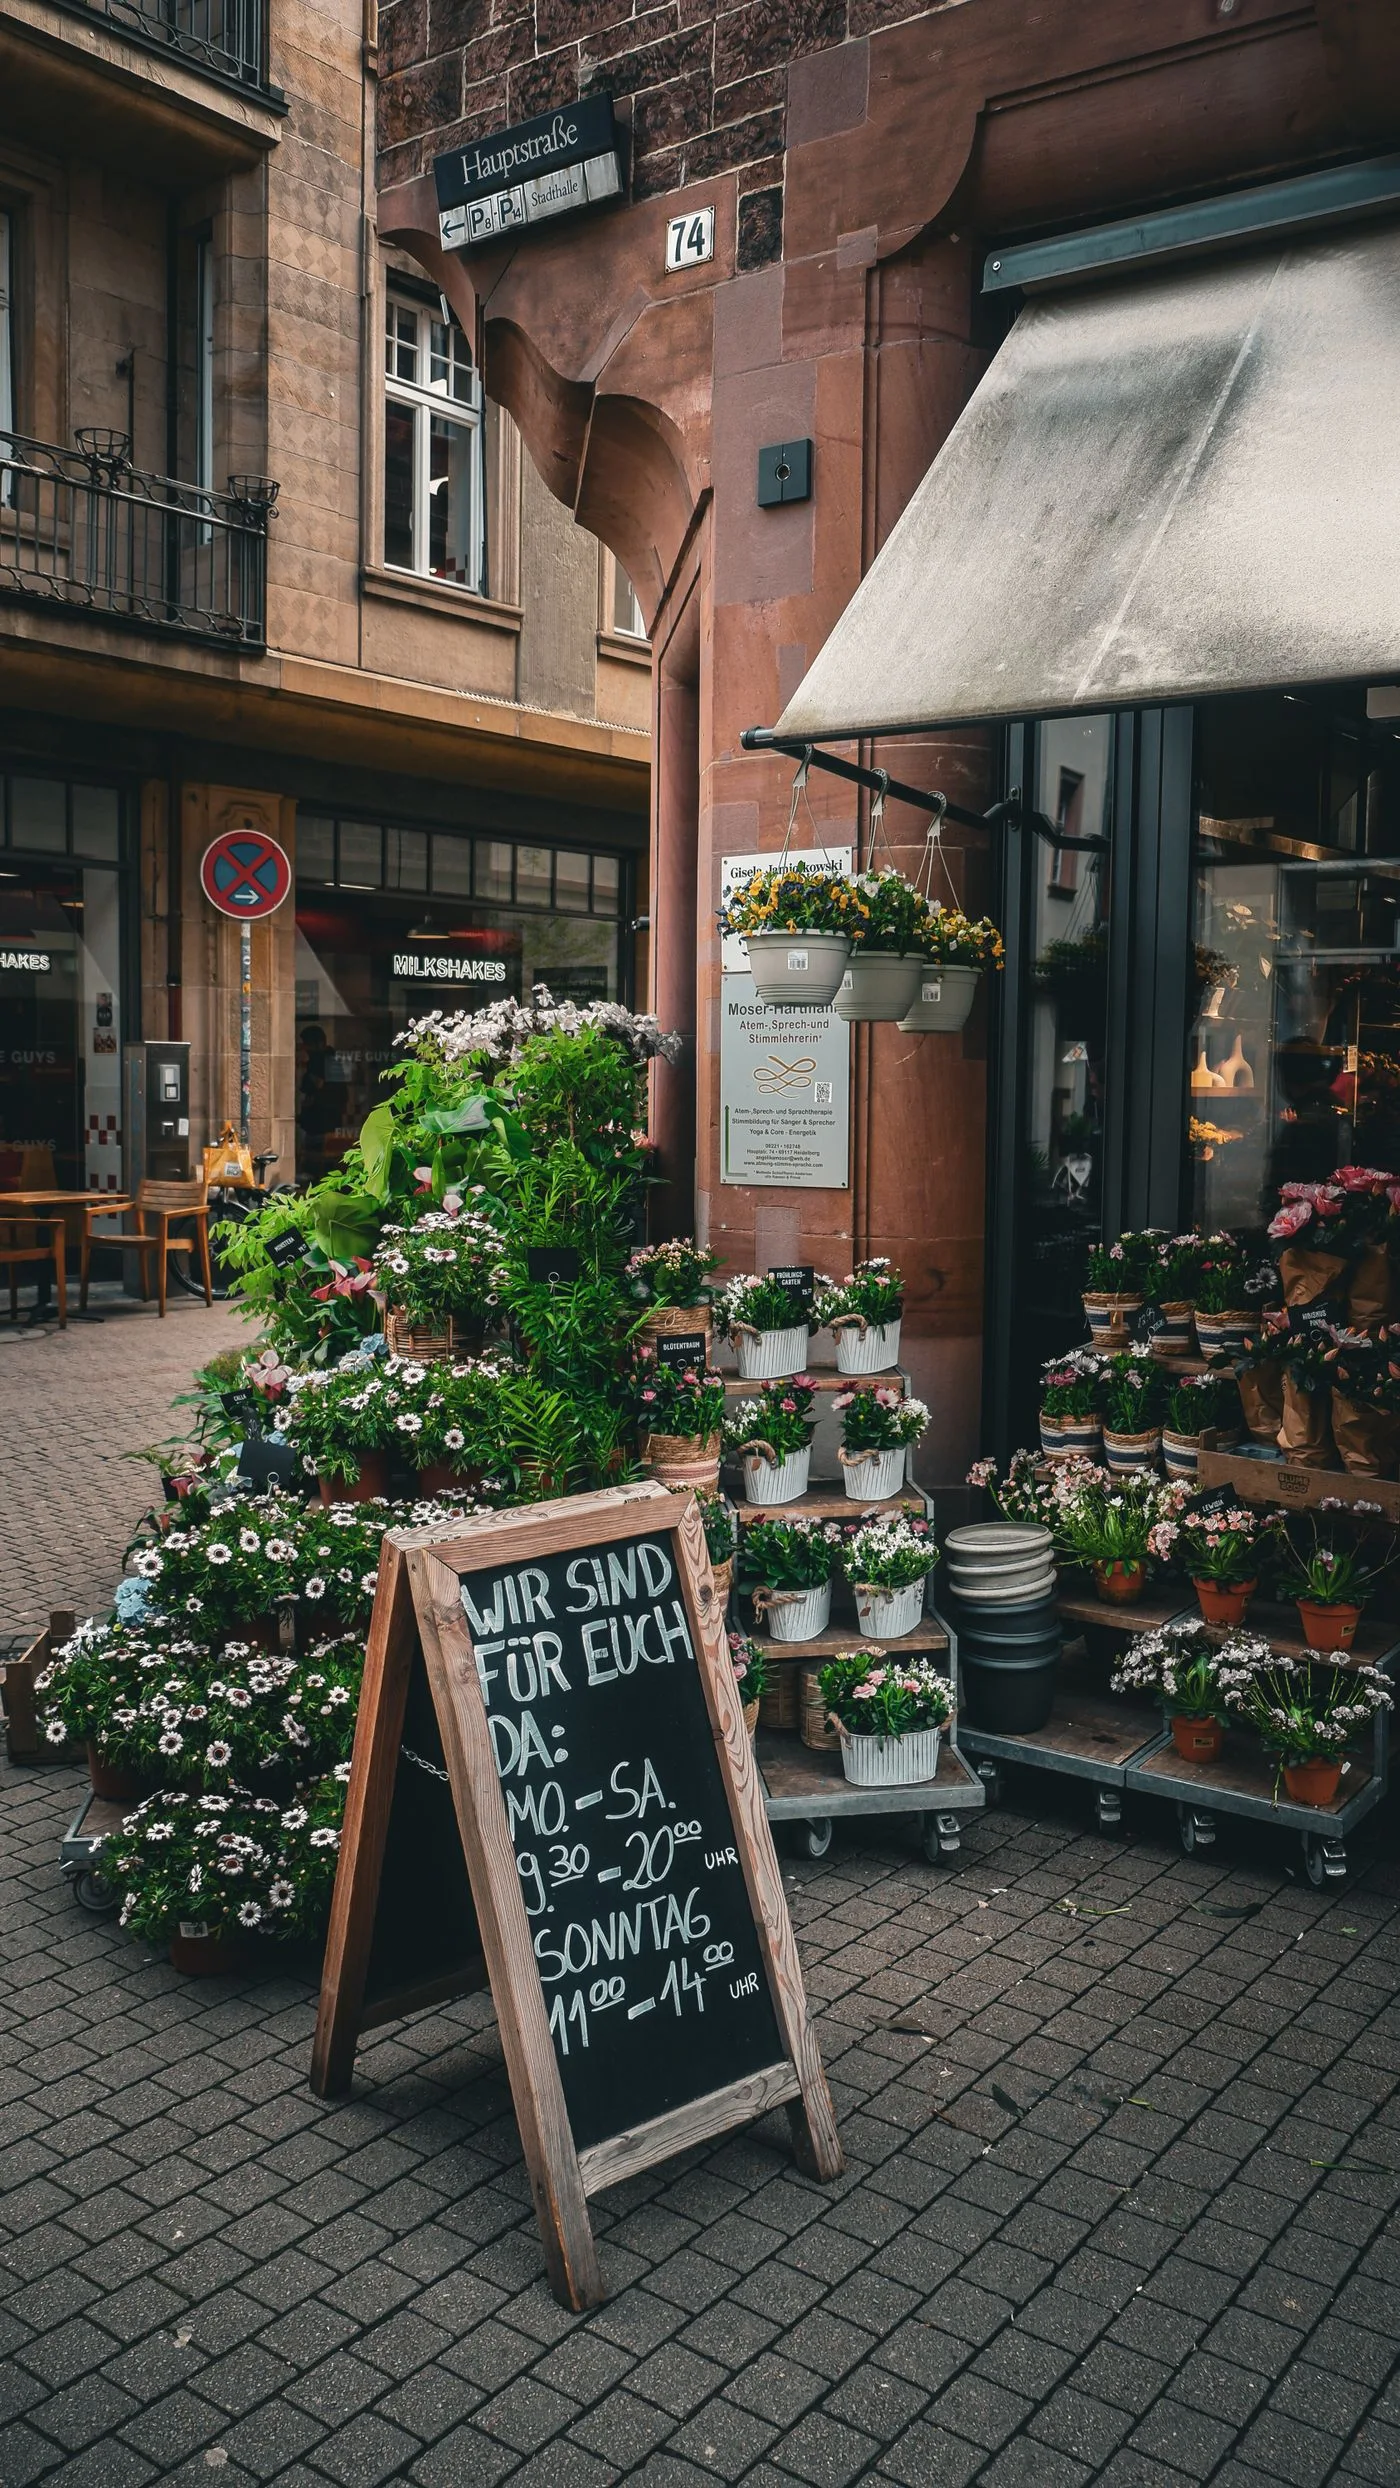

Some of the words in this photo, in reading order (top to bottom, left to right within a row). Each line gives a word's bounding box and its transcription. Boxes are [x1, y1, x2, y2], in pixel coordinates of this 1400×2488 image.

[460, 115, 579, 185] Hauptstraße
[531, 179, 579, 207] Stadthalle
[672, 216, 706, 263] 74
[766, 859, 843, 874] Jamiokowski
[393, 955, 507, 982] MILKSHAKES
[11, 1050, 57, 1064] GUYS
[732, 1118, 770, 1126] Stimmbildung
[809, 1119, 836, 1127] Sprecher
[788, 1108, 833, 1117] Sprachtherapie
[750, 1129, 764, 1137] Yoga
[789, 1129, 817, 1137] Energetik
[460, 1567, 556, 1637] WIR
[565, 1543, 673, 1613] SIND
[473, 1631, 572, 1707] FÜR
[581, 1600, 695, 1687] EUCH
[486, 1709, 569, 1779] DA:
[704, 1847, 738, 1870] UHR
[533, 1887, 711, 1982] SONNTAG
[729, 1972, 760, 2000] UHR
